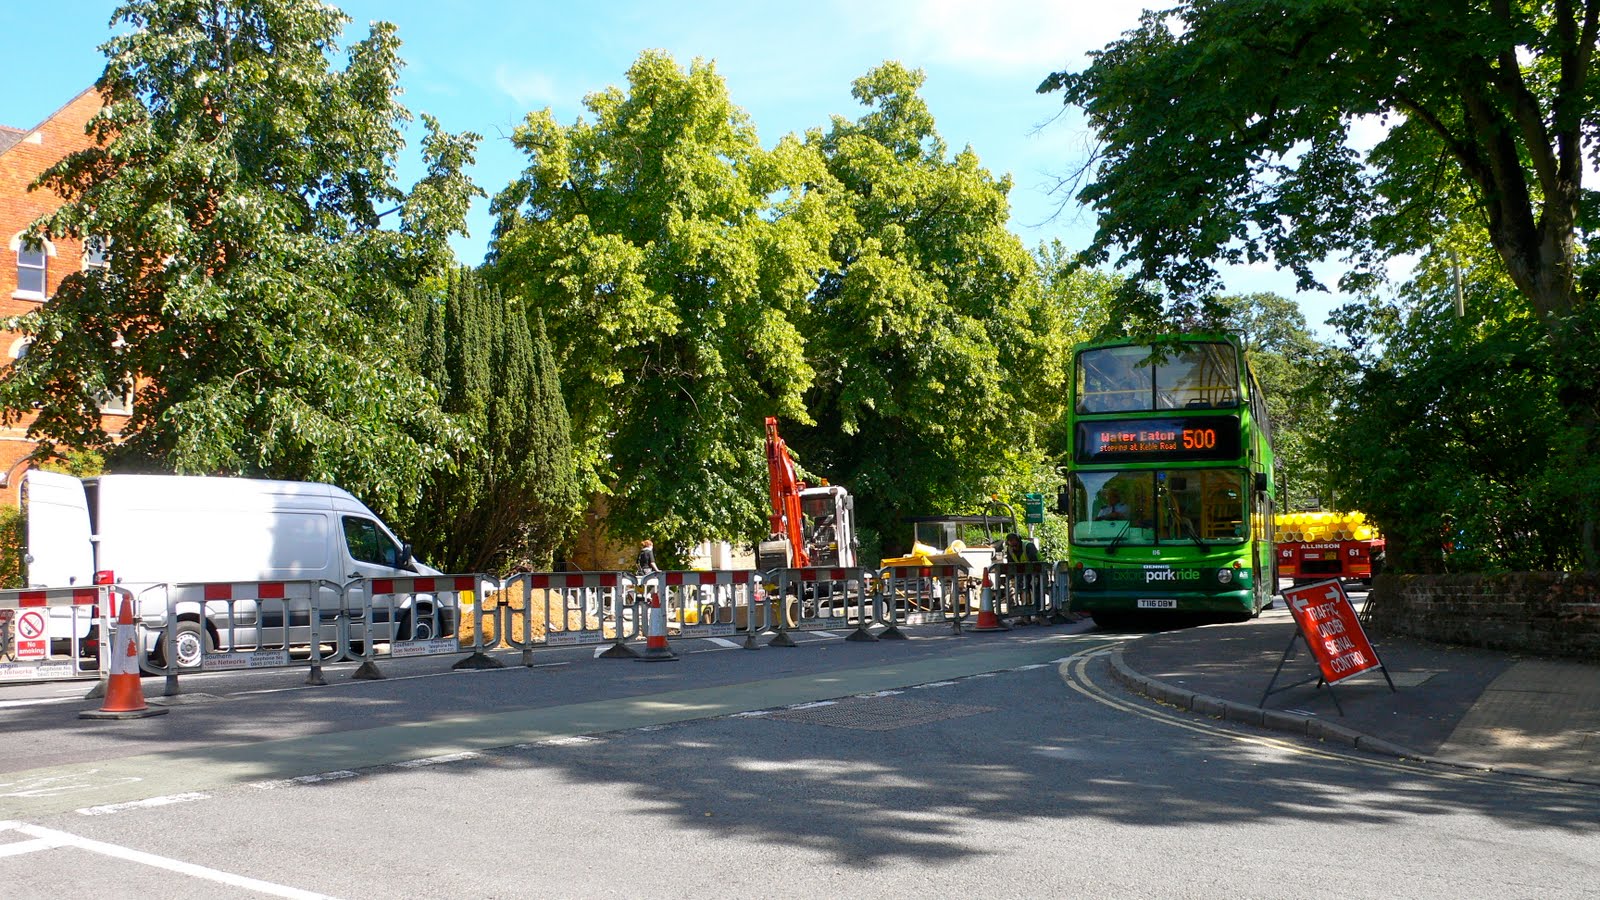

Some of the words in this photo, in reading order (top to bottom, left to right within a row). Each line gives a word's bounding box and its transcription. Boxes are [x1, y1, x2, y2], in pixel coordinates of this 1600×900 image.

[1101, 432, 1136, 442] Water
[1139, 431, 1175, 441] Eaton
[1183, 429, 1216, 449] 500
[1129, 443, 1138, 451] at
[1160, 442, 1177, 450] Road
[1282, 550, 1293, 558] 61
[1348, 548, 1360, 556] 61
[1305, 601, 1339, 622] TRAFFIC
[1315, 618, 1346, 638] UNDER
[1324, 635, 1355, 655] SIGNAL
[1330, 650, 1369, 673] CONTROL
